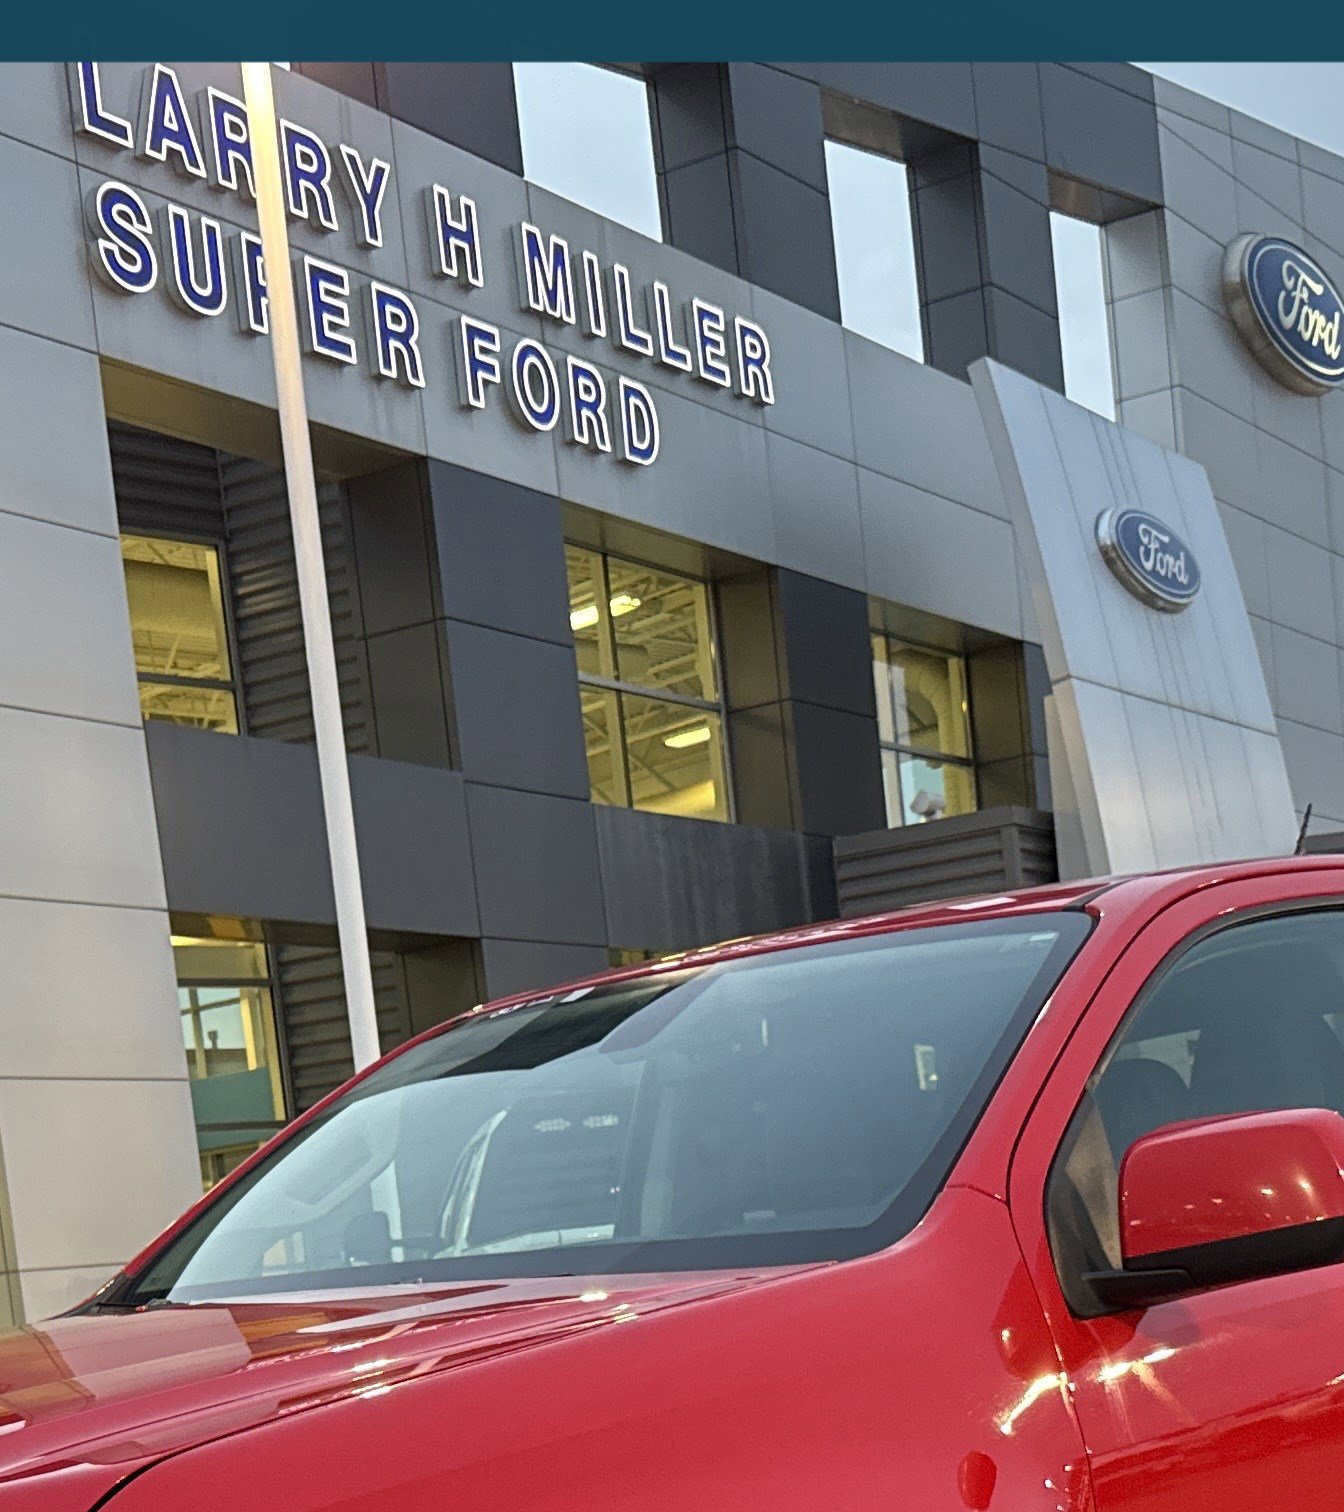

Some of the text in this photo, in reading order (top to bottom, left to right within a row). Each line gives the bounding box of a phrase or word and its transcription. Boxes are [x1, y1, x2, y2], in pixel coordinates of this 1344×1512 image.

[76, 62, 775, 404] LARRY H MILLER
[96, 181, 660, 466] SUPER FORD
[1278, 260, 1342, 360] Ford
[1138, 522, 1189, 586] Ford
